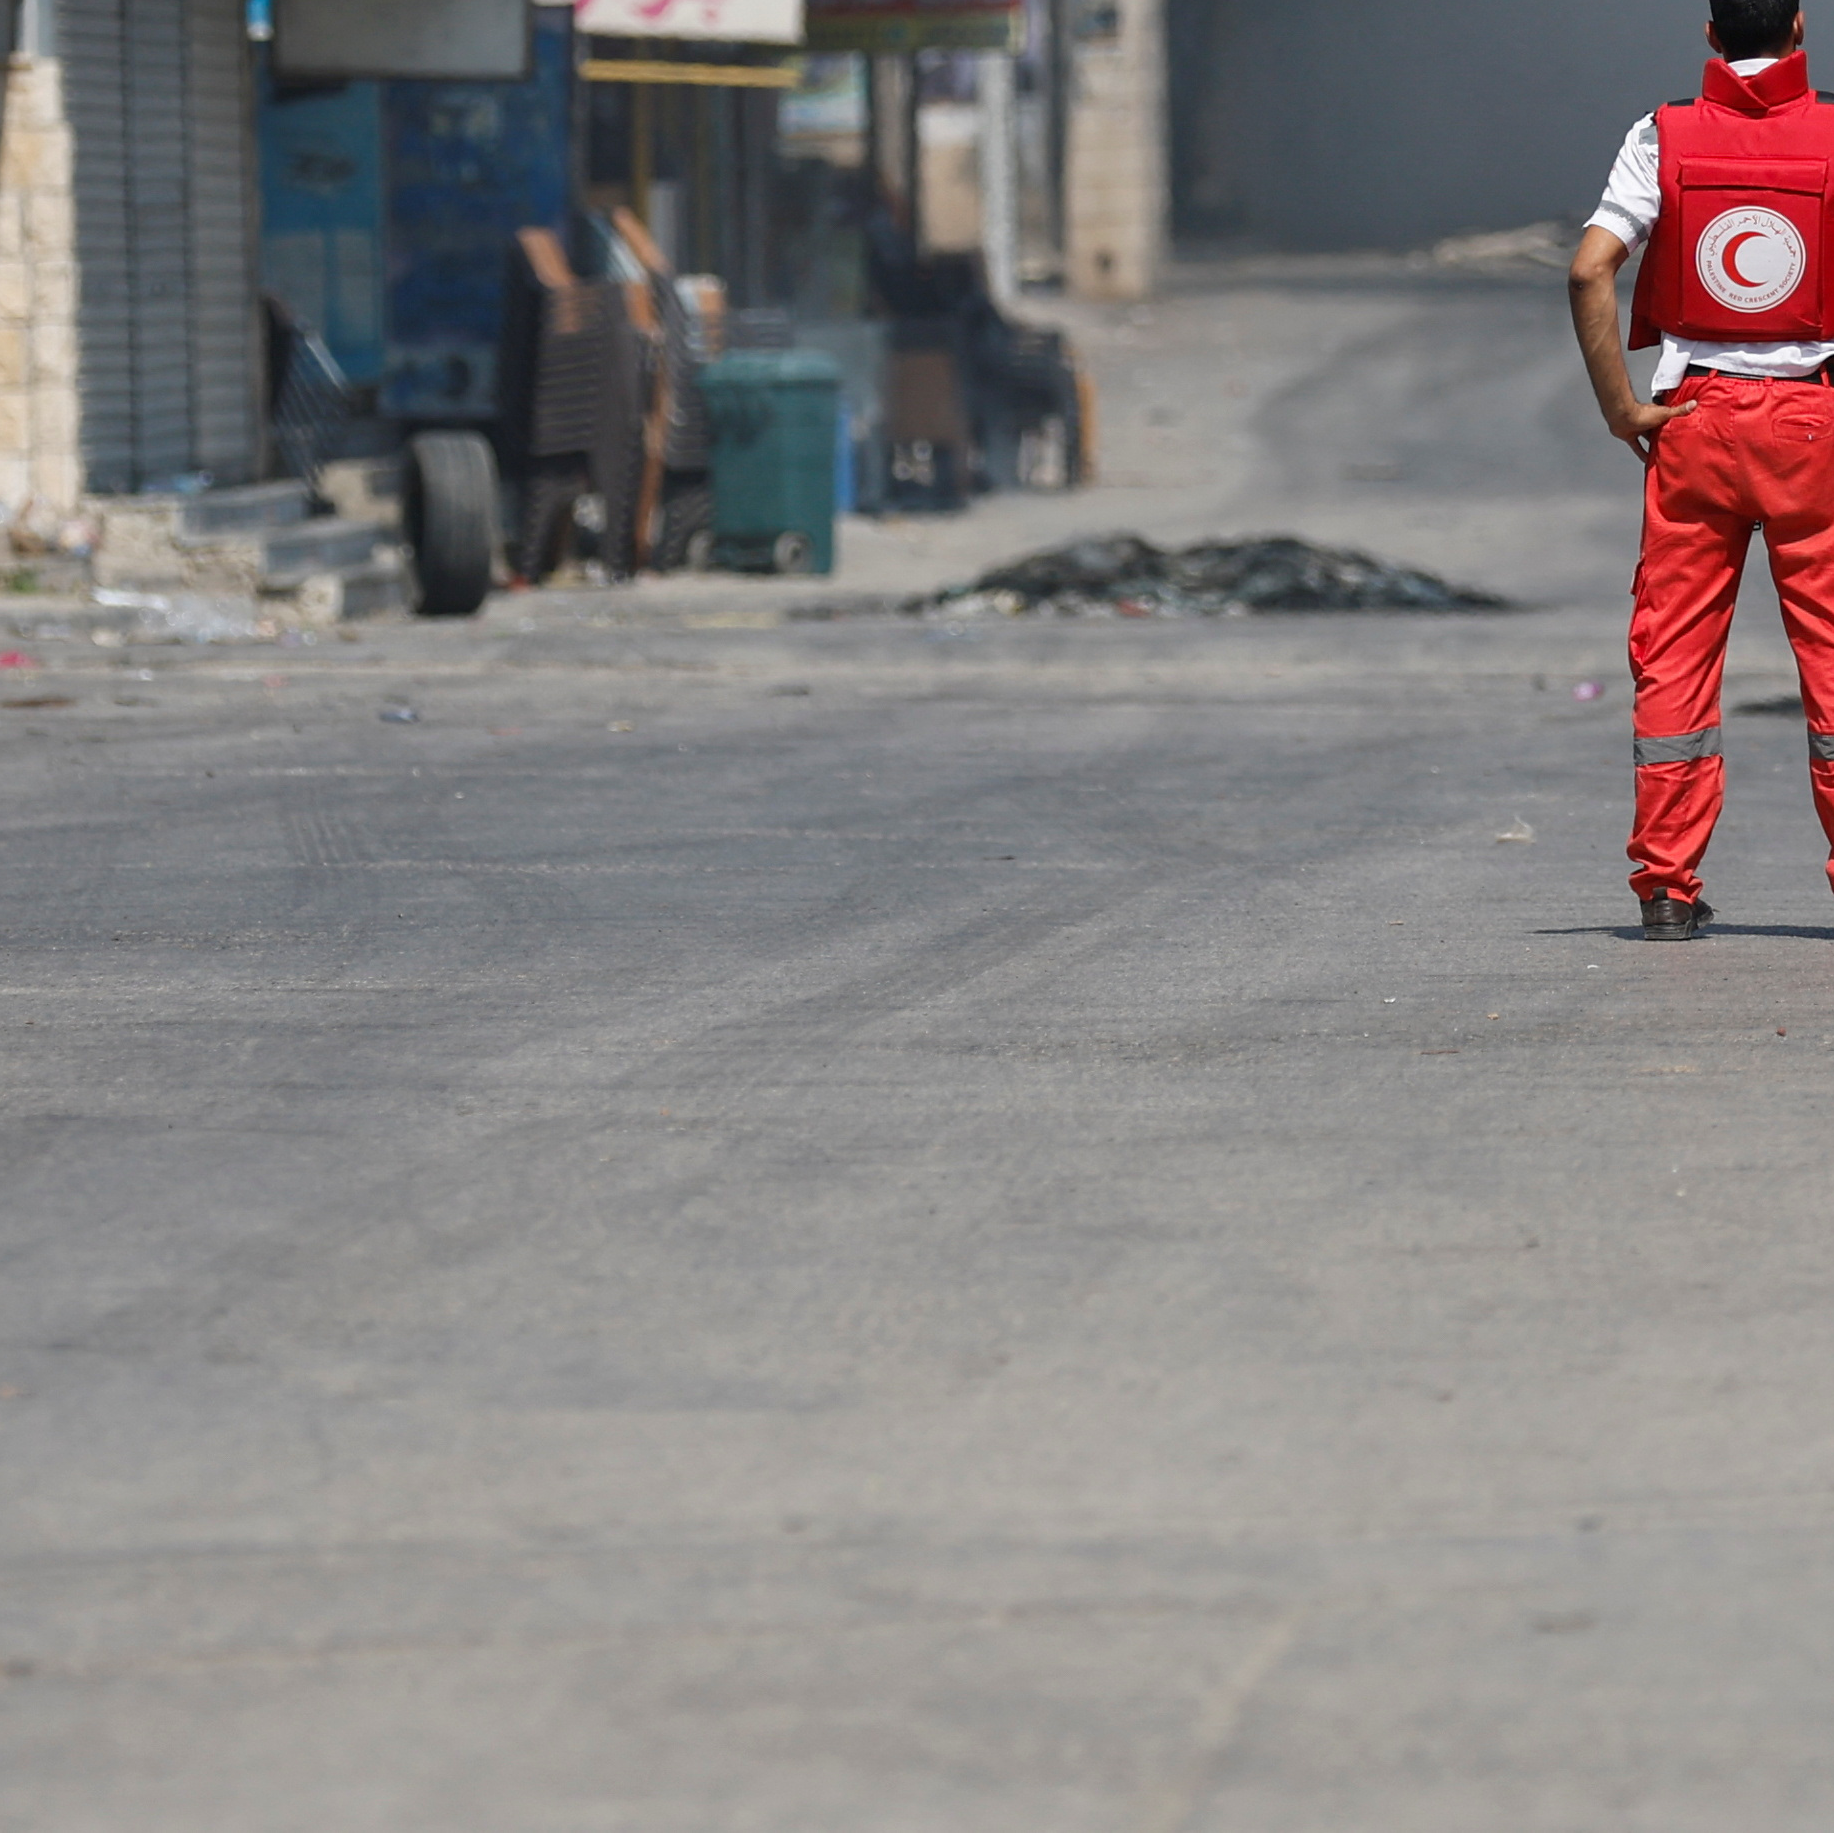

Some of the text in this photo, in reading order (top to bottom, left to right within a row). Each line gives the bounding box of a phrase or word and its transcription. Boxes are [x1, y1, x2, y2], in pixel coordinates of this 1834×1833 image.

[1706, 260, 1797, 304] PALESTINE RED CRESCENT SOCIETY
